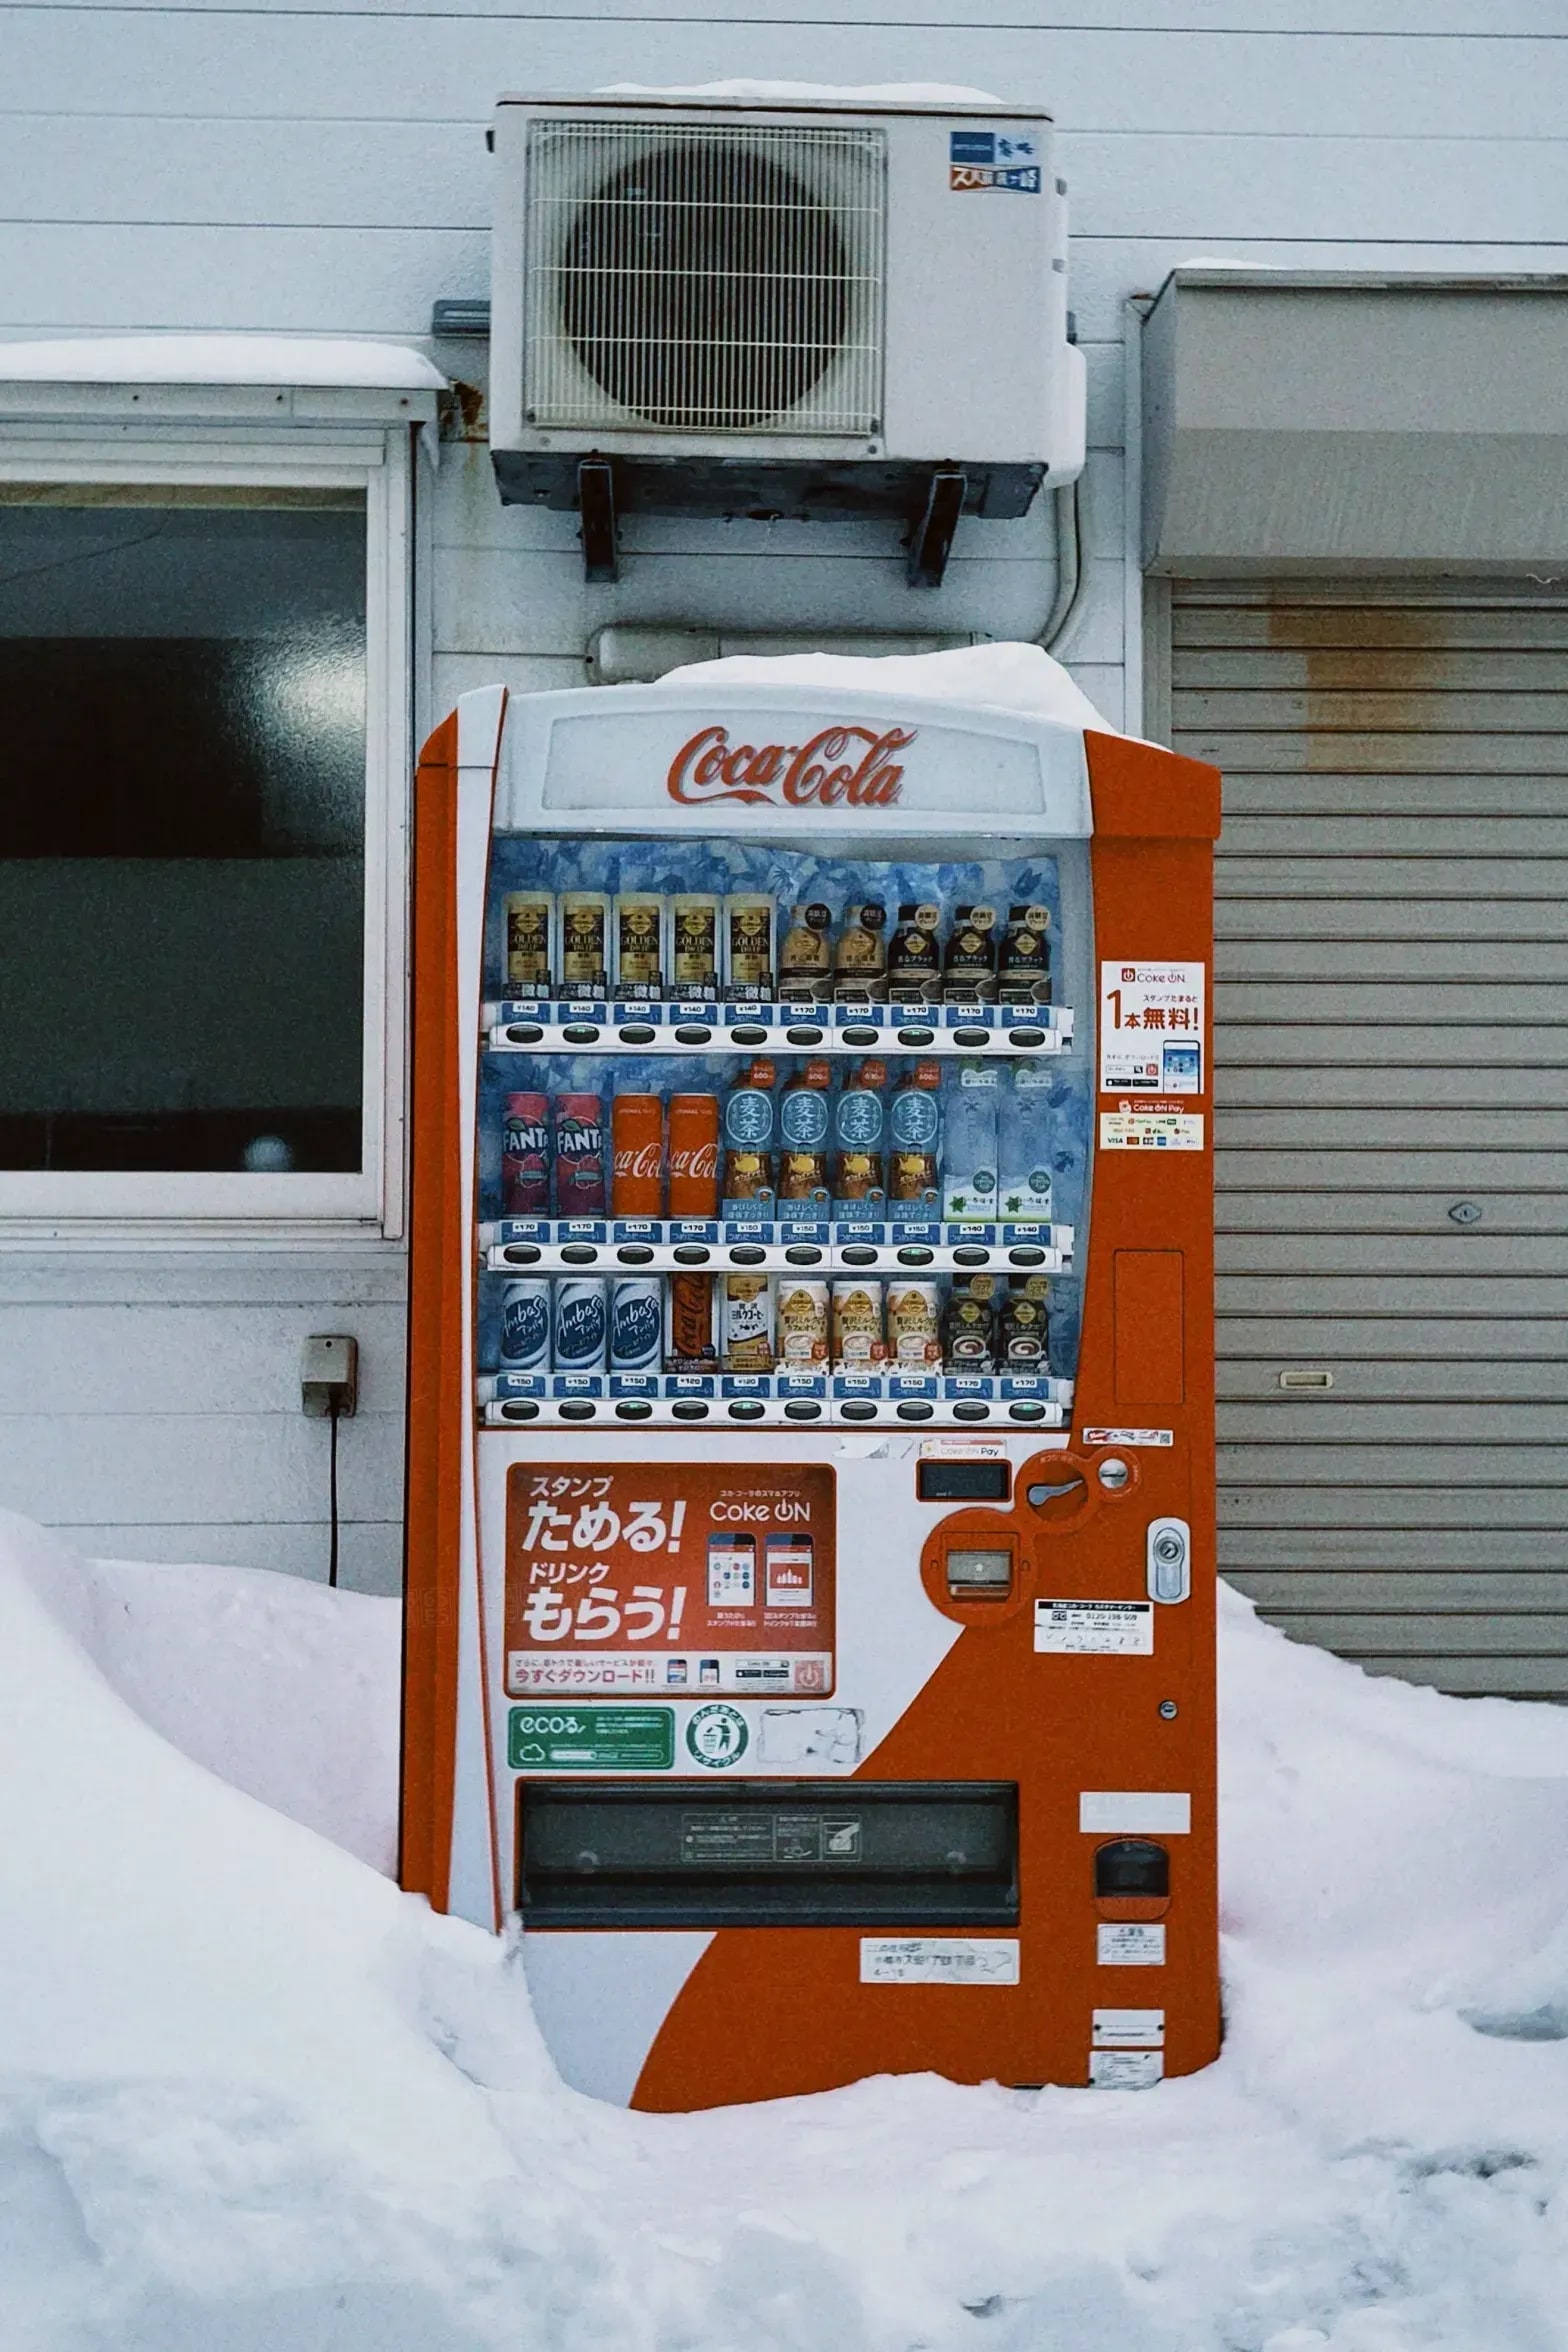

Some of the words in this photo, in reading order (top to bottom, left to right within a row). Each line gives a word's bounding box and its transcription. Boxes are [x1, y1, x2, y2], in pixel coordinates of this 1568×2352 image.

[667, 725, 918, 807] Coca-Cola
[1137, 973, 1166, 983] Coke
[1106, 989, 1199, 1031] 1本無料!
[740, 1096, 760, 1138] 麦茶
[795, 1096, 815, 1138] 麦茶
[850, 1096, 870, 1138] 麦茶
[904, 1098, 926, 1138] 麦茶
[1168, 1104, 1185, 1114] Pay
[981, 1447, 999, 1457] Pay
[528, 1476, 614, 1497] スタンプ
[522, 1500, 687, 1553] ためる!
[709, 1501, 770, 1522] Coke
[774, 1498, 811, 1522] ON
[529, 1561, 611, 1584] ドリンク
[522, 1586, 687, 1641] もらう!
[515, 1669, 655, 1684] 今すぐダウンロード!!
